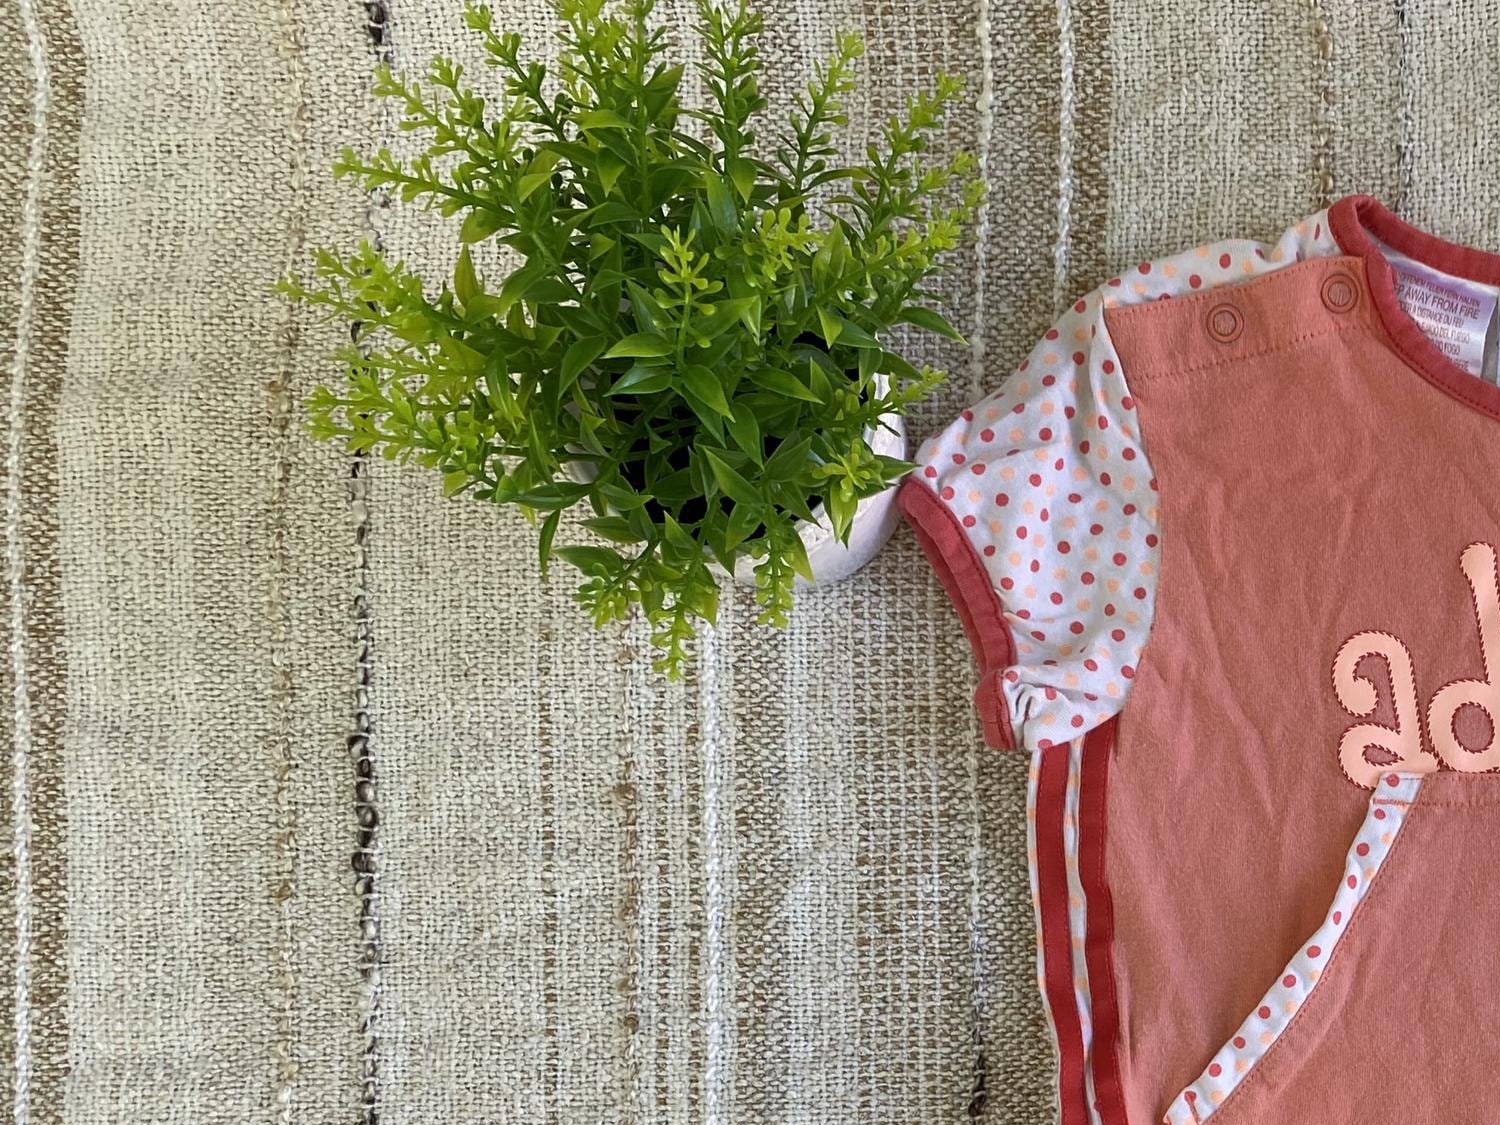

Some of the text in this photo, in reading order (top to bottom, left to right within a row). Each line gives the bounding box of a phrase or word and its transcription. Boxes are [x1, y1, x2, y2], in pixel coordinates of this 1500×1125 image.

[1405, 286, 1432, 304] AWAY
[1431, 295, 1459, 314] FROM
[1459, 305, 1481, 320] FIRE
